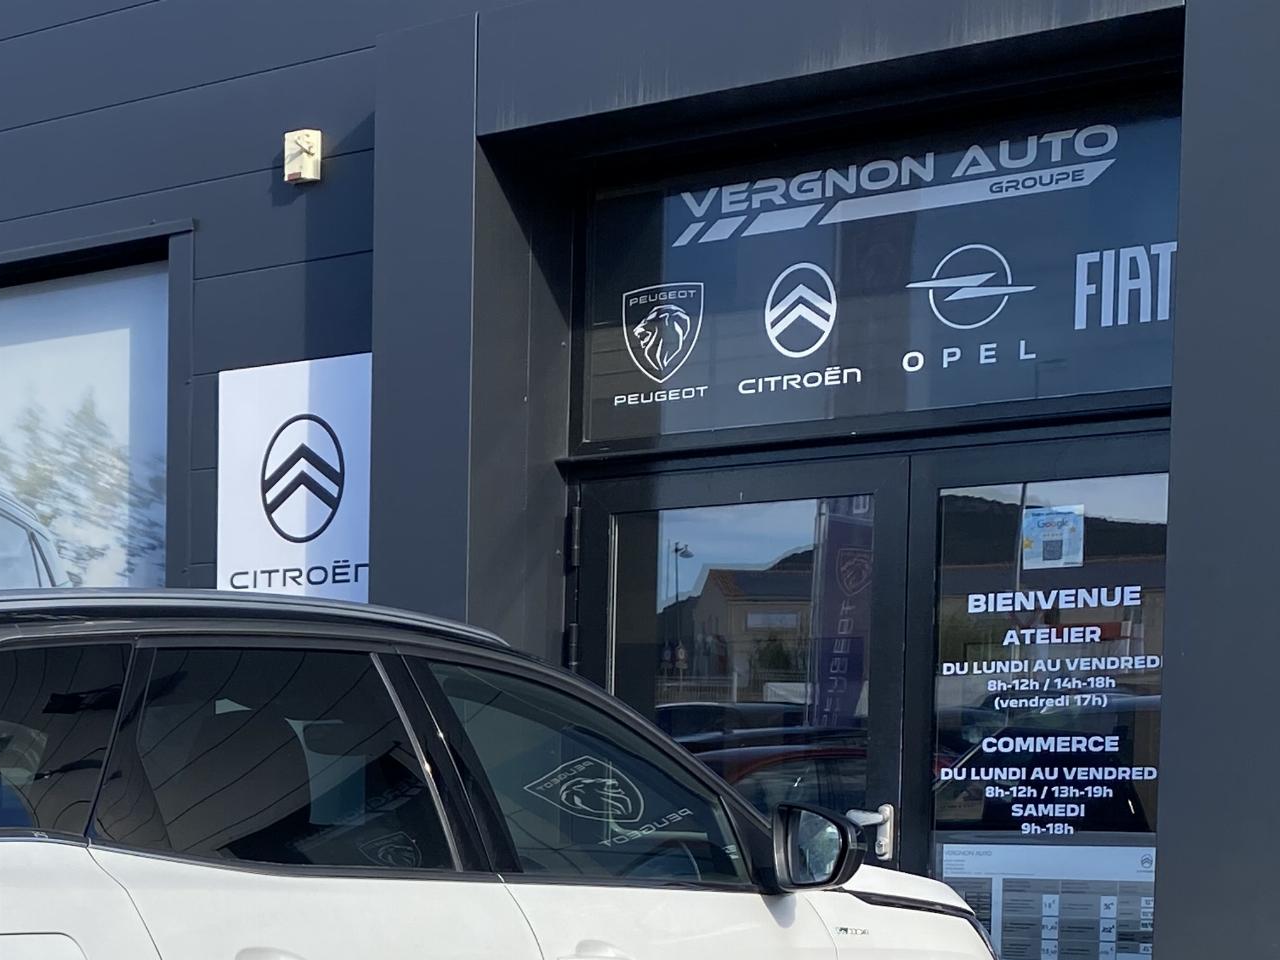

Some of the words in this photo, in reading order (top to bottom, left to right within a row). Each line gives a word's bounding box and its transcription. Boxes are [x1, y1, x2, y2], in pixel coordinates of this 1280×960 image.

[681, 152, 934, 217] VERGNON
[951, 124, 1119, 178] AUTO
[989, 169, 1085, 193] GROUPE
[1074, 241, 1178, 330] FIAT
[629, 290, 697, 306] PEUGEOT
[614, 386, 709, 406] PEUGEOT
[968, 585, 1142, 613] BIENVENUE
[1003, 626, 1102, 646] ATELIER
[942, 661, 968, 675] DU
[973, 660, 1029, 674] LUNDI
[1032, 658, 1061, 672] AU
[987, 680, 1040, 692] 8h-12h
[1054, 676, 1116, 690] 14h-18h
[994, 695, 1070, 710] (vendredi
[1074, 693, 1108, 708] 17h)
[981, 735, 1120, 753] COMMERCE
[940, 768, 967, 781] DU
[970, 767, 1027, 780] LUNDI
[1030, 767, 1060, 780] AU
[1062, 767, 1158, 780] VENDRED
[985, 786, 1038, 798] 8h-12h
[1051, 786, 1113, 798] 13h-19h
[1011, 803, 1085, 817] SAMEDI
[1021, 822, 1074, 835] 9h-18h
